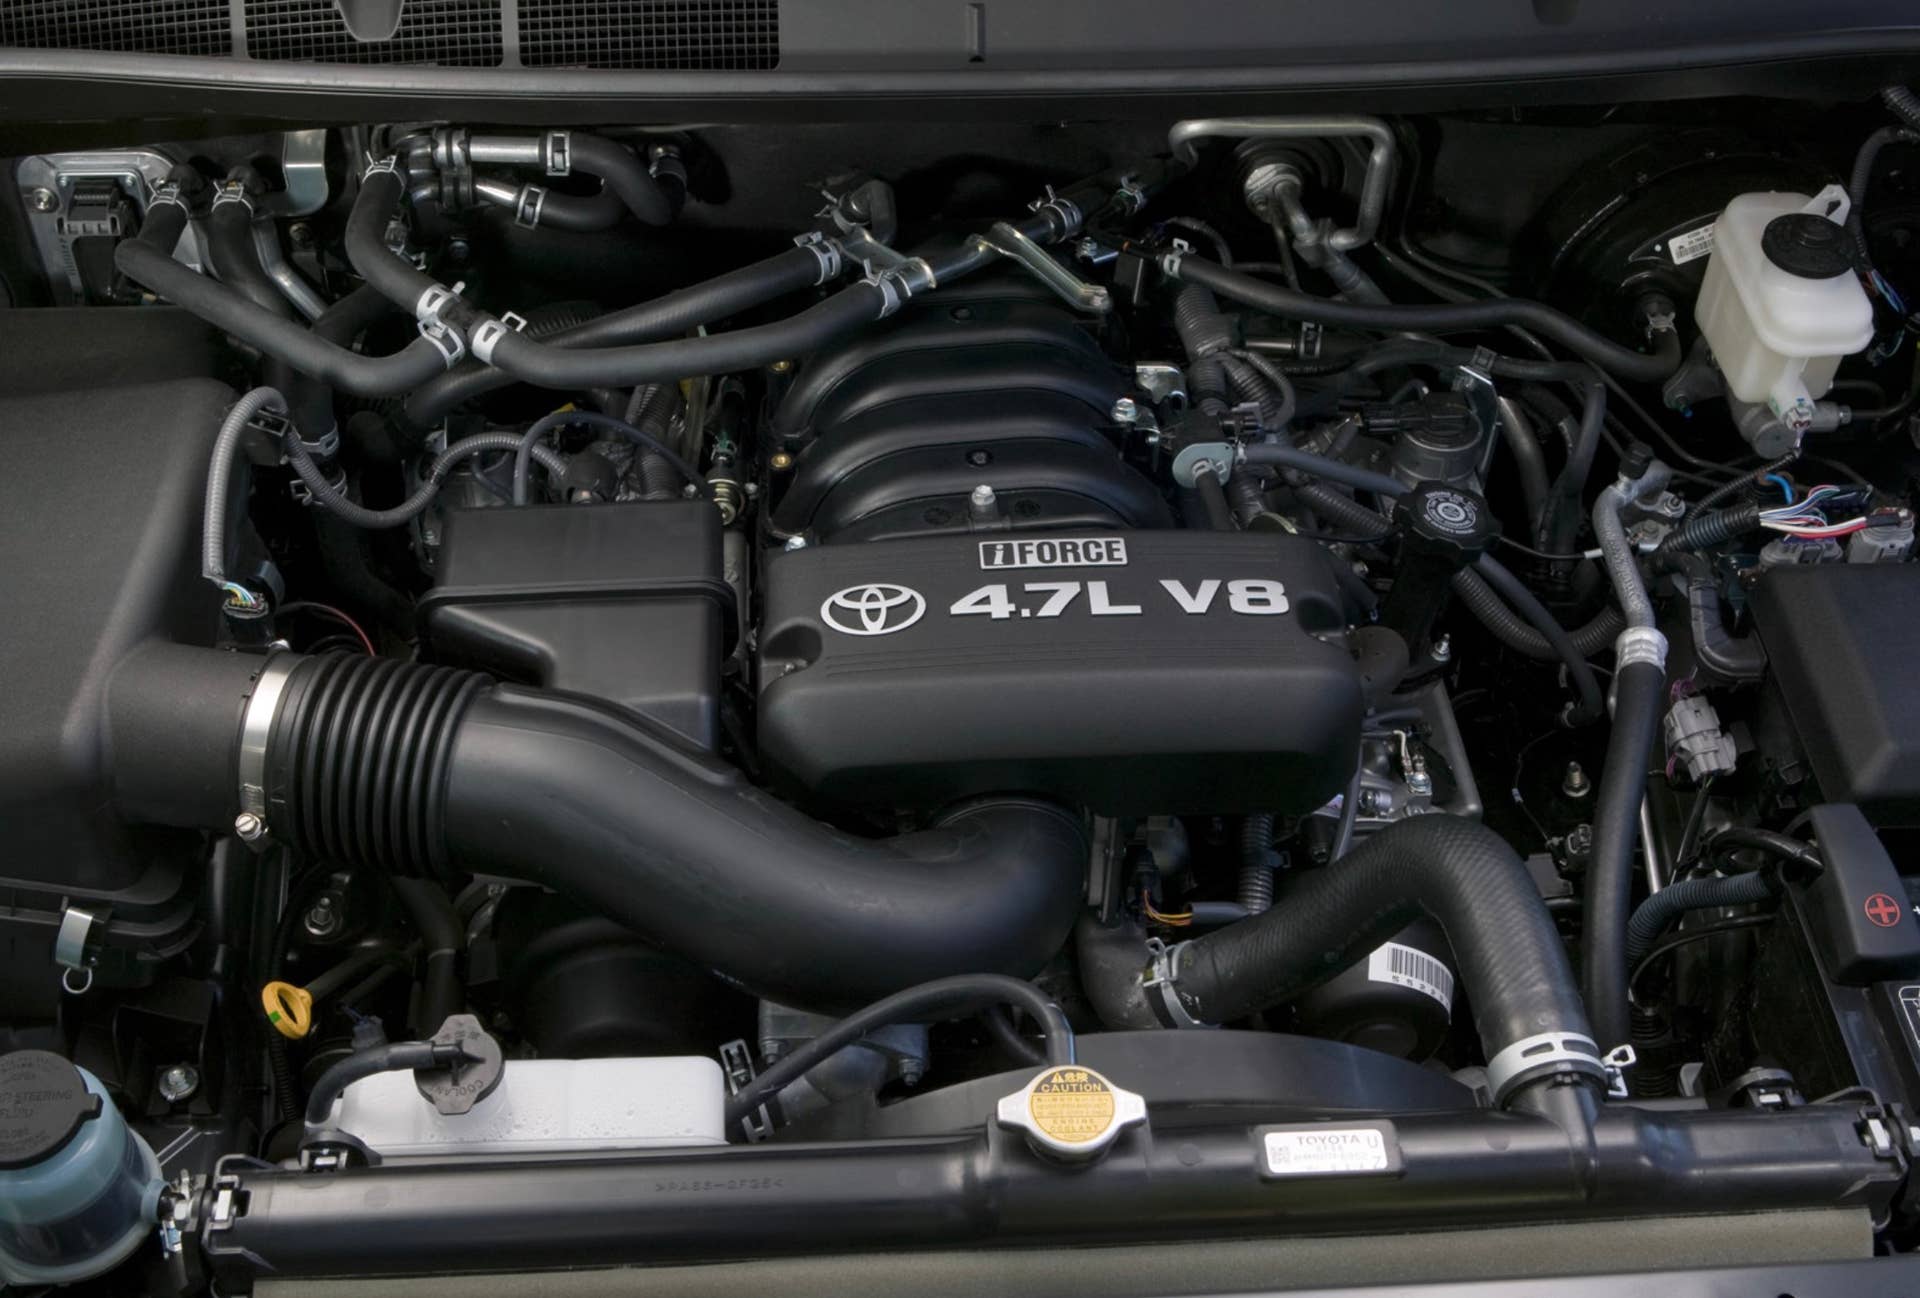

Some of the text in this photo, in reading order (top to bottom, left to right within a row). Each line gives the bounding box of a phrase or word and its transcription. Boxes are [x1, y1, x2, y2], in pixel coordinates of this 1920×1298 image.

[950, 579, 1290, 619] 4.7L V8
[1041, 1083, 1102, 1093] CAUTION
[1296, 1135, 1361, 1146] TOYOTA
